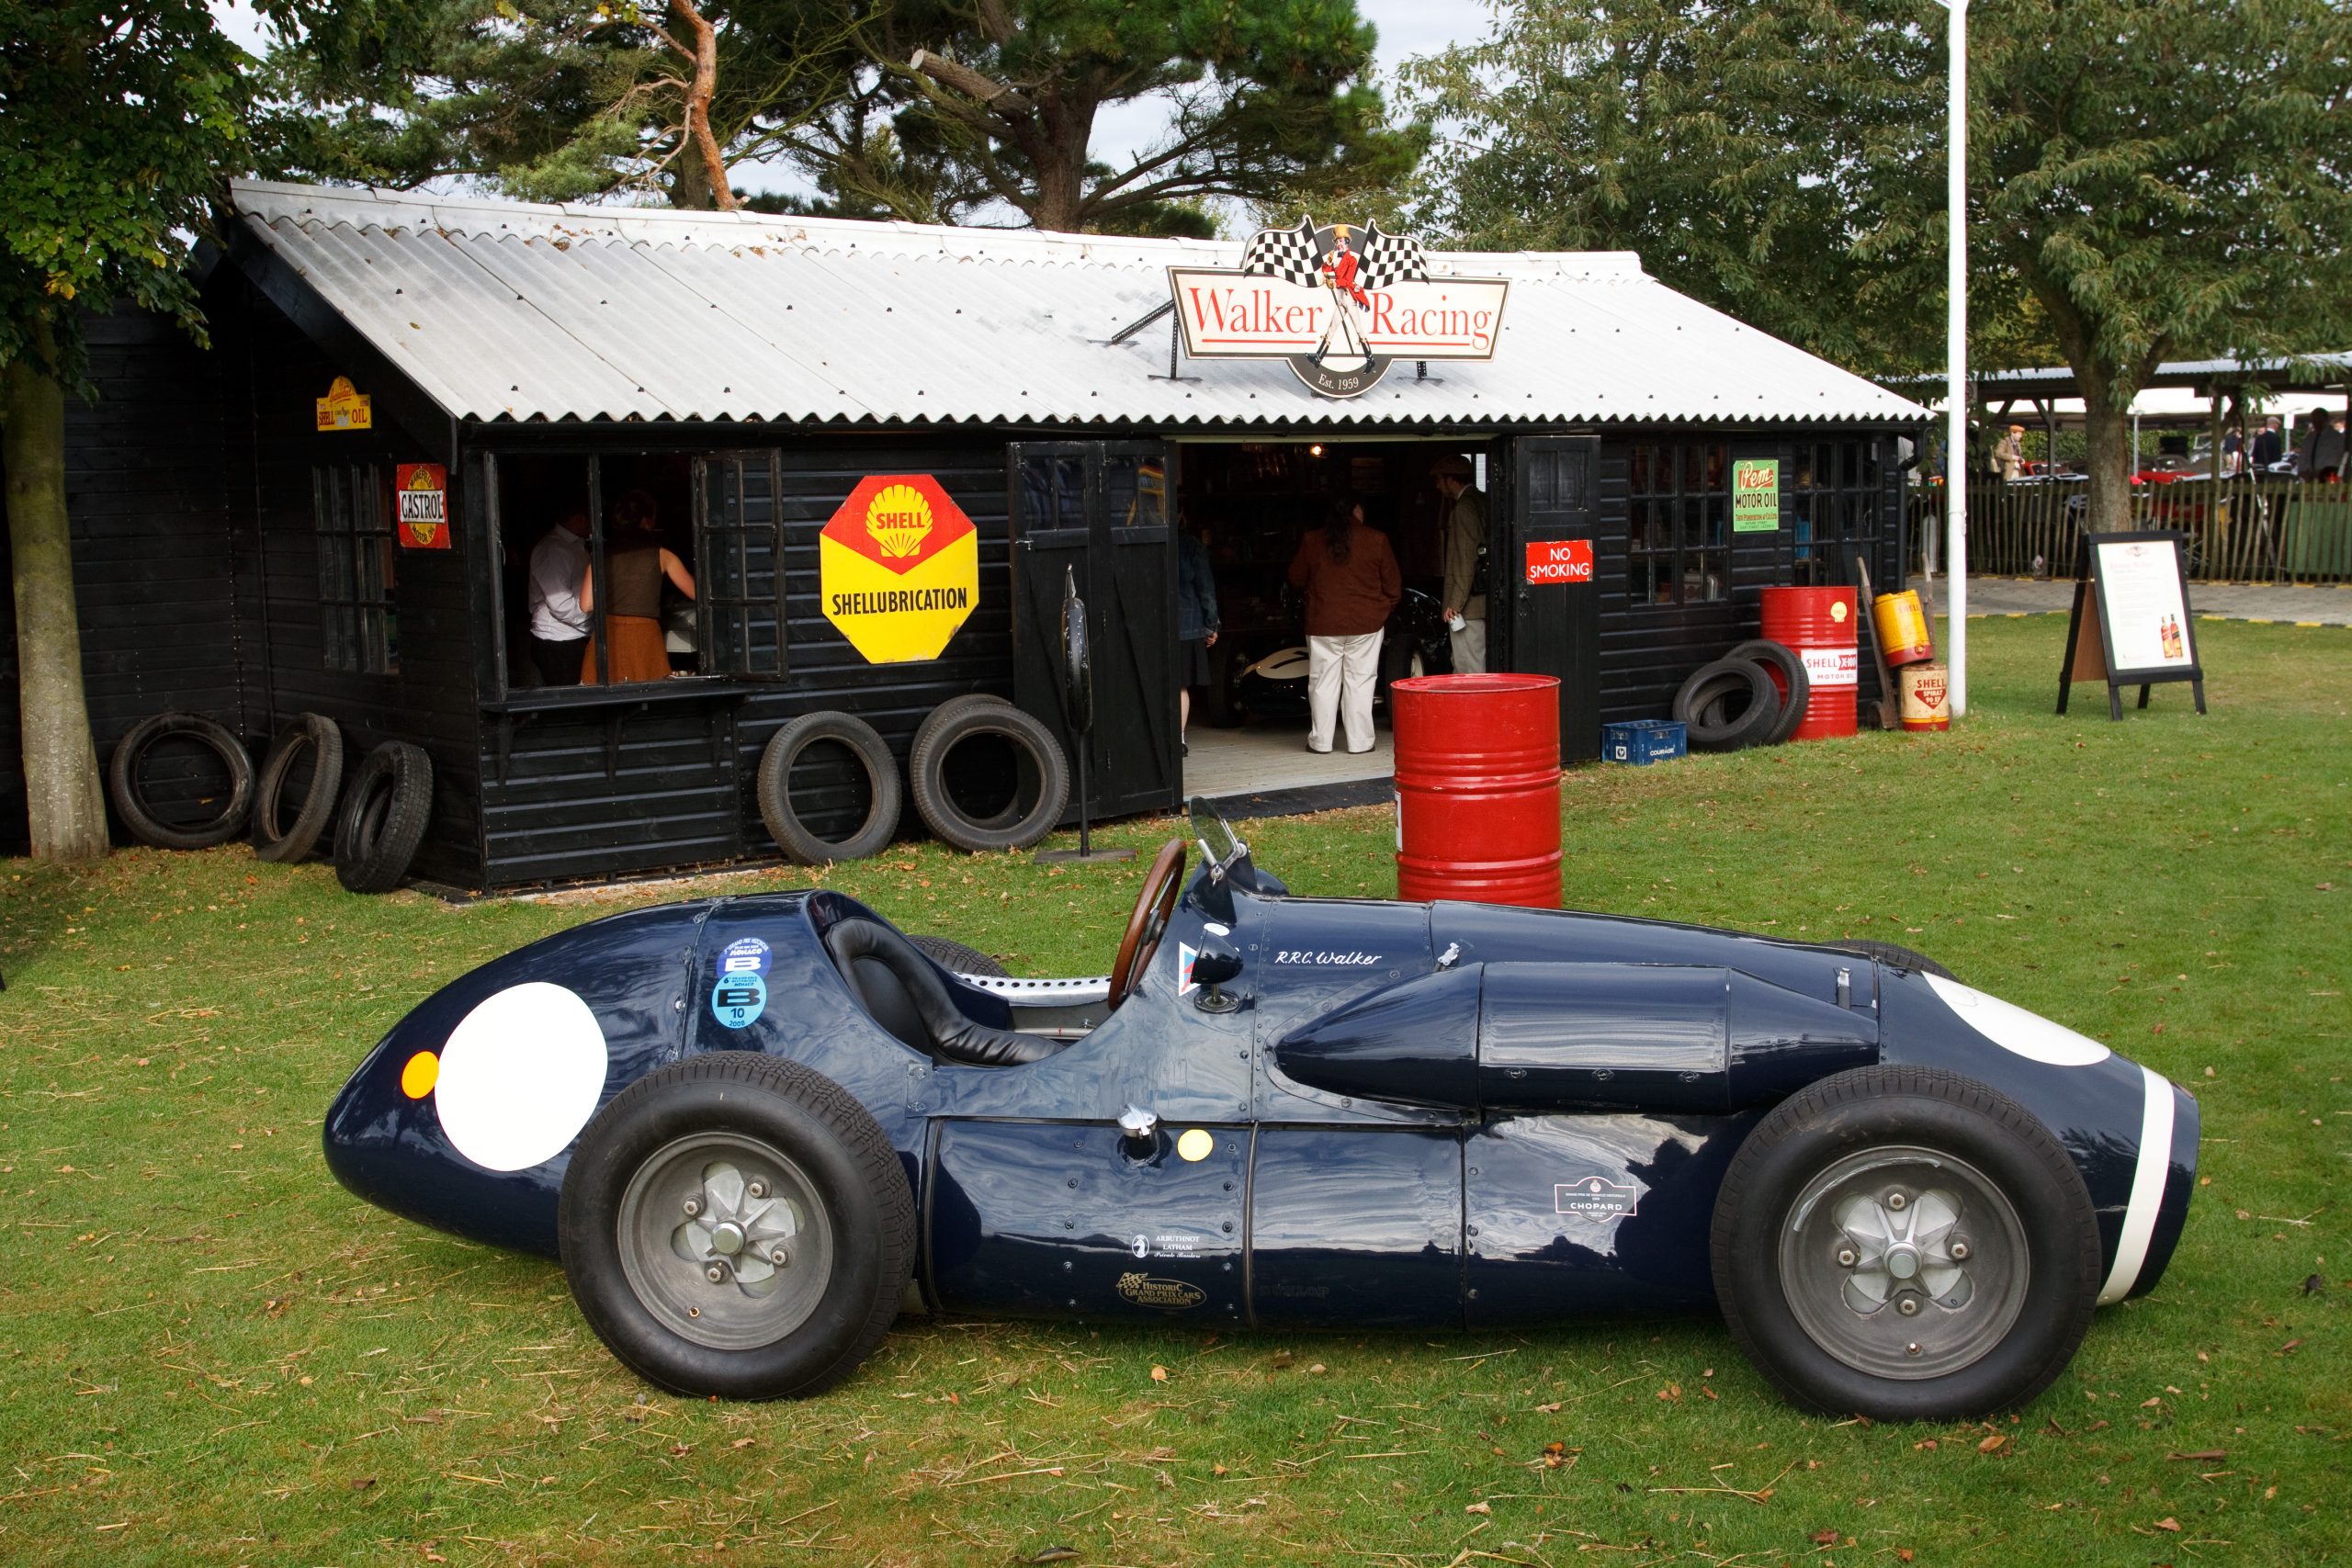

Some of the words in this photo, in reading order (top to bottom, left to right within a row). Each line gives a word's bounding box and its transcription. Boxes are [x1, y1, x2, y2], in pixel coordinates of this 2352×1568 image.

[1189, 288, 1323, 333] Walker
[1369, 292, 1493, 351] Racing
[1318, 373, 1334, 389] Est.
[1338, 377, 1359, 390] 1959
[319, 411, 334, 425] SHELL
[352, 408, 368, 423] OIL
[401, 494, 443, 519] CASTROL
[1735, 492, 1762, 509] MOTOR
[1764, 492, 1778, 508] OIL
[876, 512, 925, 530] SHELL
[412, 525, 428, 543] MOTOR
[1550, 547, 1571, 561] NO
[1530, 562, 1590, 579] SMOKING
[831, 587, 967, 616] SHELLUBRICATION
[1806, 658, 1838, 669] SHELL
[1917, 678, 1945, 689] SHELL
[1650, 747, 1675, 757] COURAGE
[729, 948, 763, 956] MONACO
[1316, 952, 1383, 965] Walker
[725, 956, 762, 972] B
[718, 987, 761, 1008] B
[730, 1007, 745, 1019] 10
[1570, 1202, 1623, 1211] CHOPARD
[1155, 1235, 1200, 1243] ARBUTHNOT
[1162, 1243, 1193, 1251] LATHAM
[1142, 1281, 1182, 1292] HISTORIC
[1125, 1287, 1156, 1297] GRAND
[1157, 1290, 1176, 1298] PRIX
[1178, 1291, 1201, 1300] CARS
[1137, 1295, 1192, 1305] ASSOCIATION
